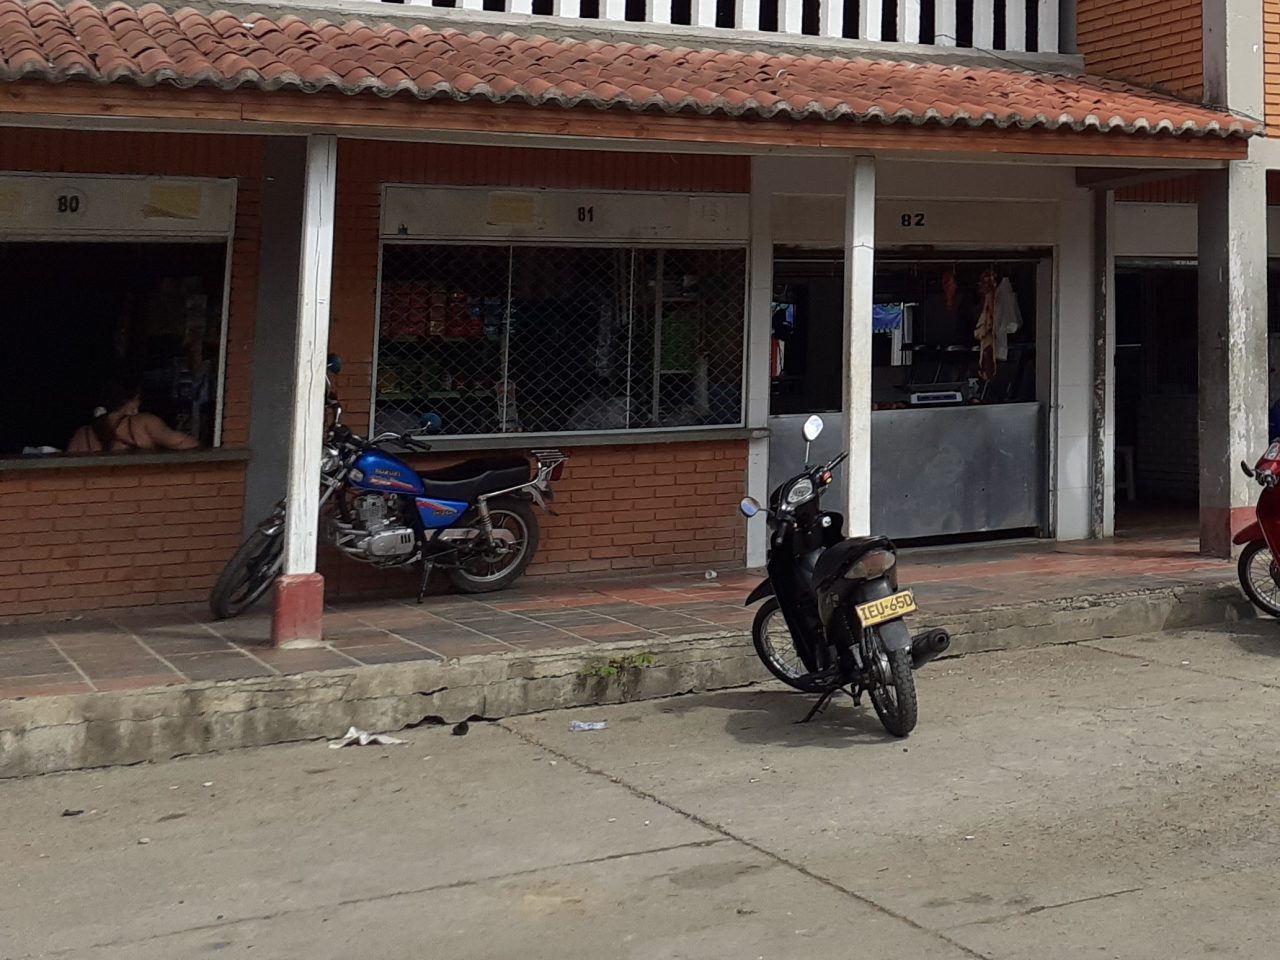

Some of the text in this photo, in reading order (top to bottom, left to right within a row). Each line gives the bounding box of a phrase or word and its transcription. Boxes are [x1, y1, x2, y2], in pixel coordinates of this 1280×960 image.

[57, 195, 80, 213] 80
[577, 206, 594, 223] 81
[901, 213, 925, 227] 82
